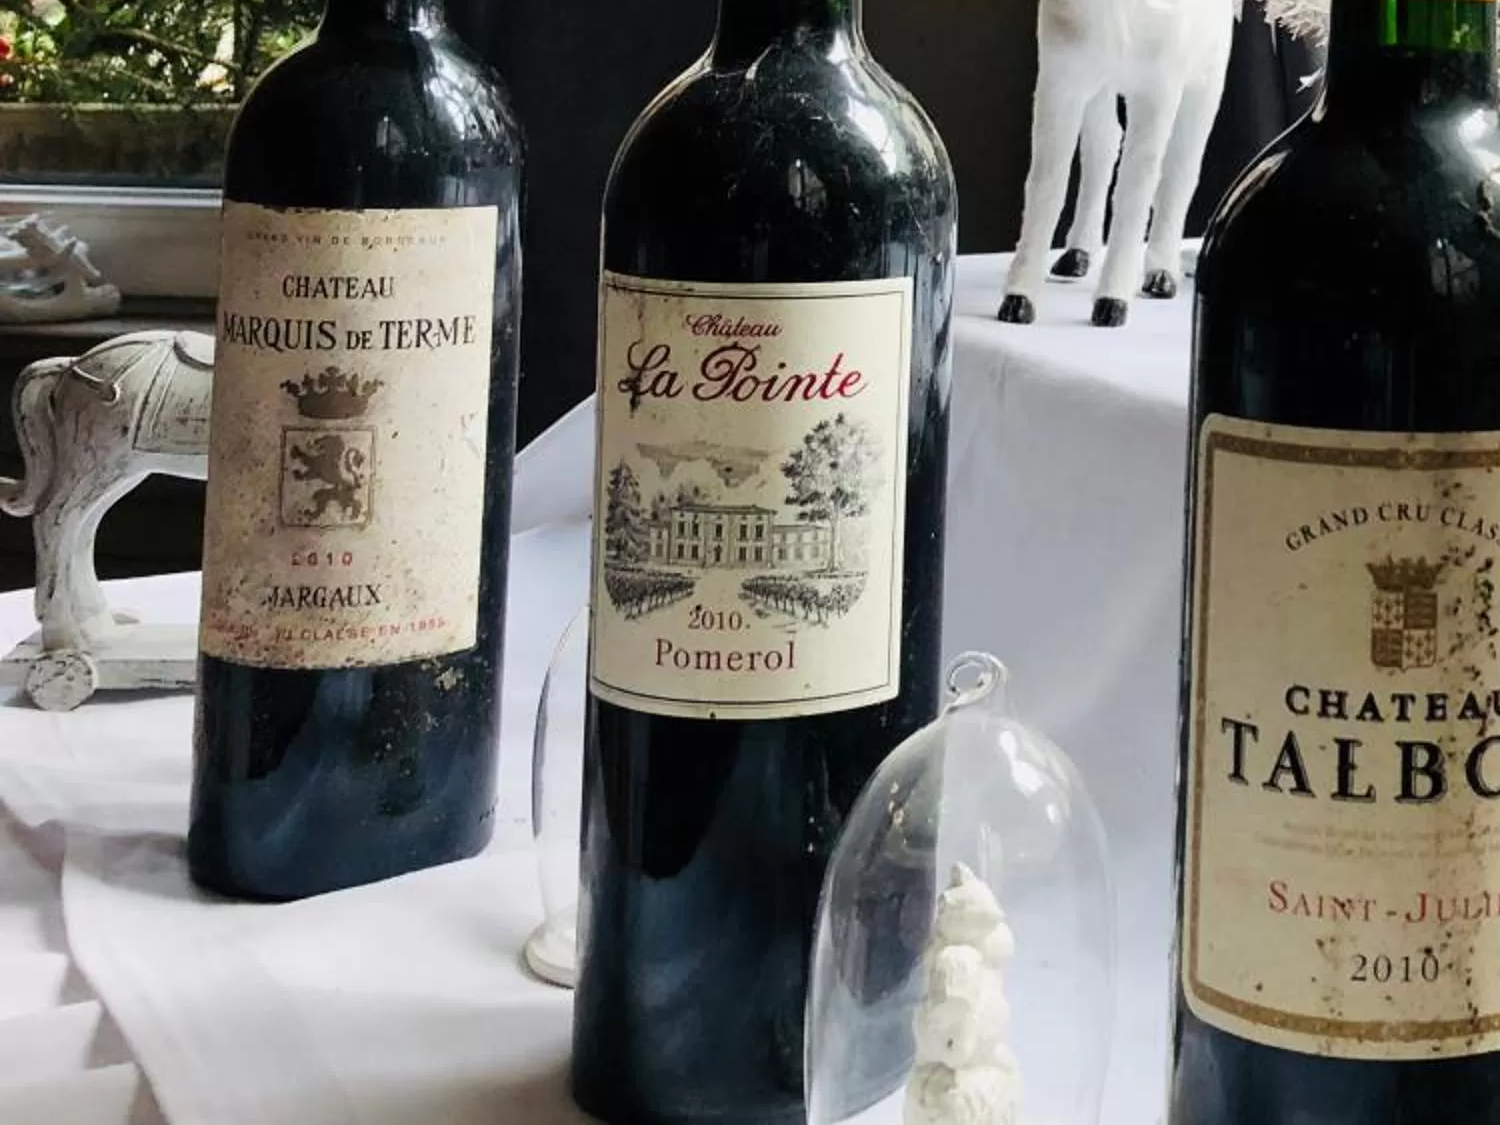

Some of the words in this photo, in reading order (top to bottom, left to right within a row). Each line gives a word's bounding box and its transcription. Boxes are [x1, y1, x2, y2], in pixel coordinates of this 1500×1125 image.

[282, 275, 395, 299] CHATEAU
[222, 311, 337, 353] MARQUIS
[380, 315, 476, 350] TERME
[618, 340, 683, 401] La
[693, 340, 868, 402] Pointe
[1285, 505, 1370, 552] GRAND
[1377, 502, 1430, 523] CRU
[656, 637, 798, 671] Pomerol
[1351, 954, 1440, 982] 2010
